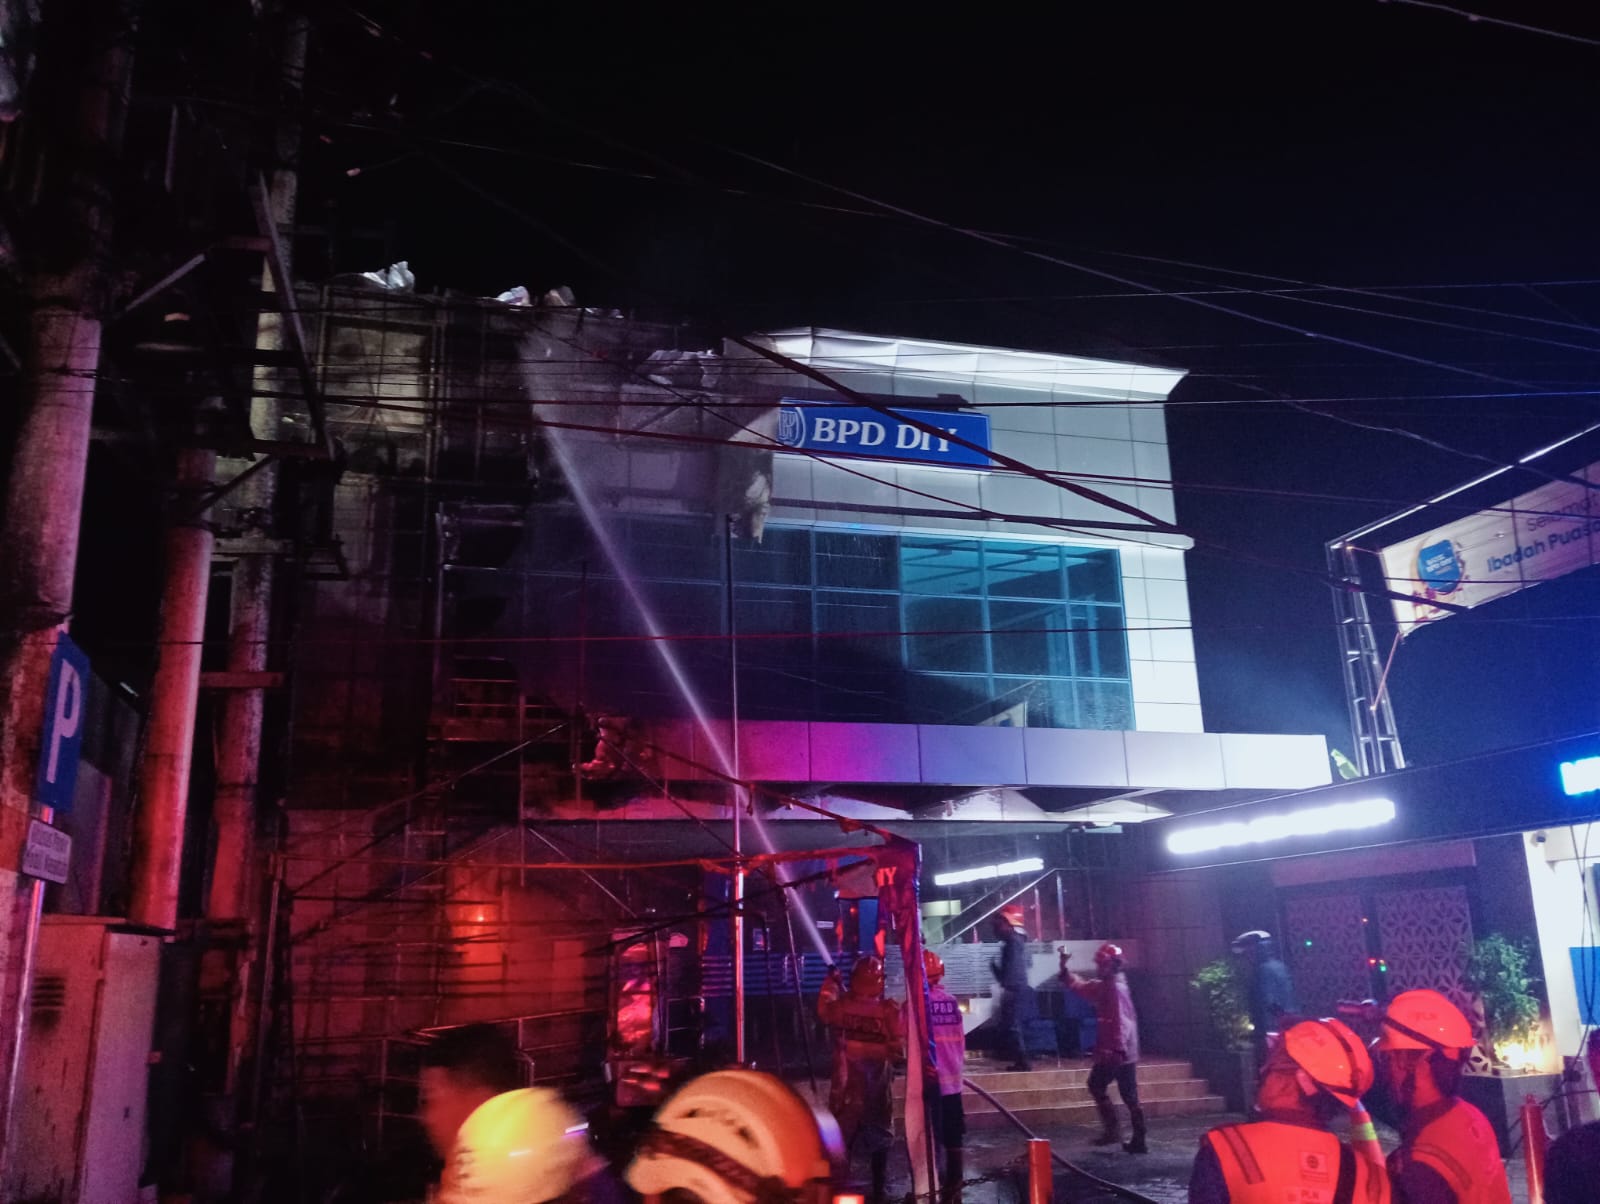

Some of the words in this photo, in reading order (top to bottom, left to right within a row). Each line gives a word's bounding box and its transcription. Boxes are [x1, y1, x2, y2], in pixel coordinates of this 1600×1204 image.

[812, 417, 886, 446] BPD
[896, 424, 957, 452] DIY
[1527, 493, 1600, 532] Seama
[1487, 540, 1546, 573] Ibadah
[46, 658, 82, 784] P
[930, 1002, 953, 1014] PBD
